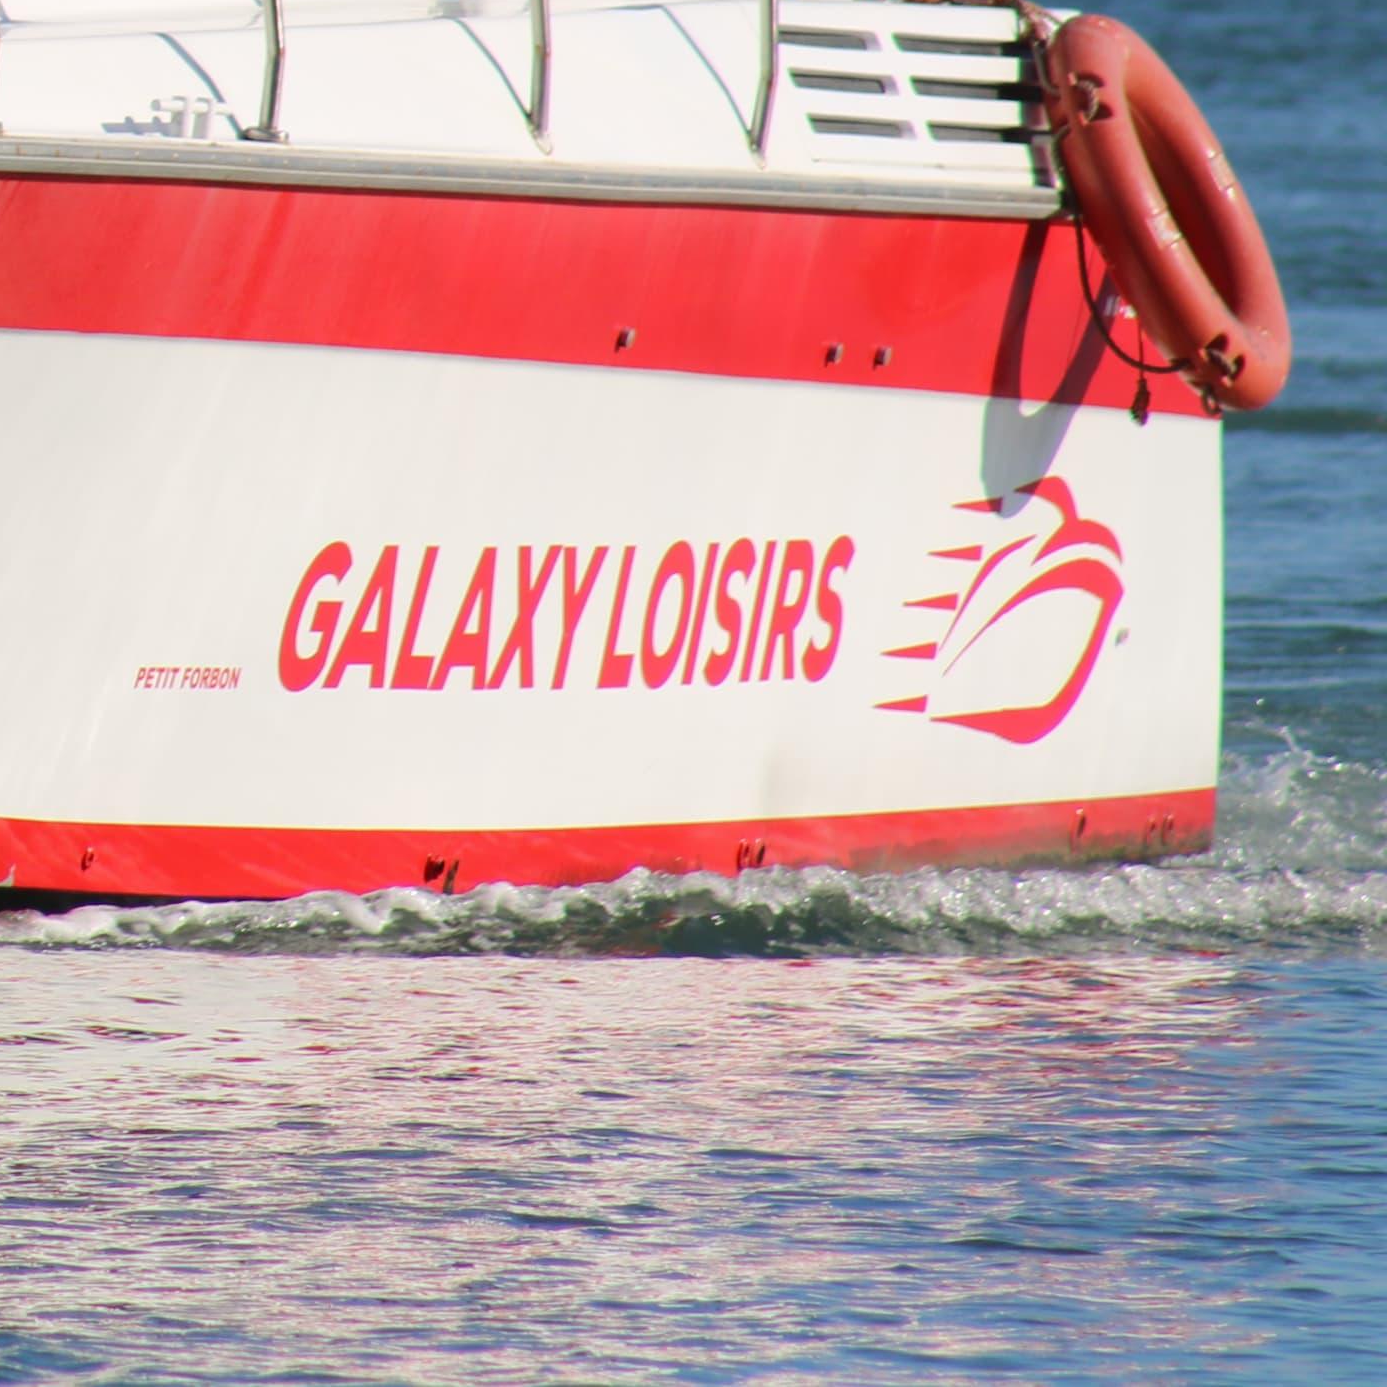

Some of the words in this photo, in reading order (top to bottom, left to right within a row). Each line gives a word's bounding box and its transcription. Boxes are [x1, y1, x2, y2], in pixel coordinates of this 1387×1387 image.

[278, 541, 610, 693] GALAXY
[597, 535, 856, 690] LOISIRS
[133, 666, 181, 689] PETIT
[180, 666, 241, 690] FORBON
